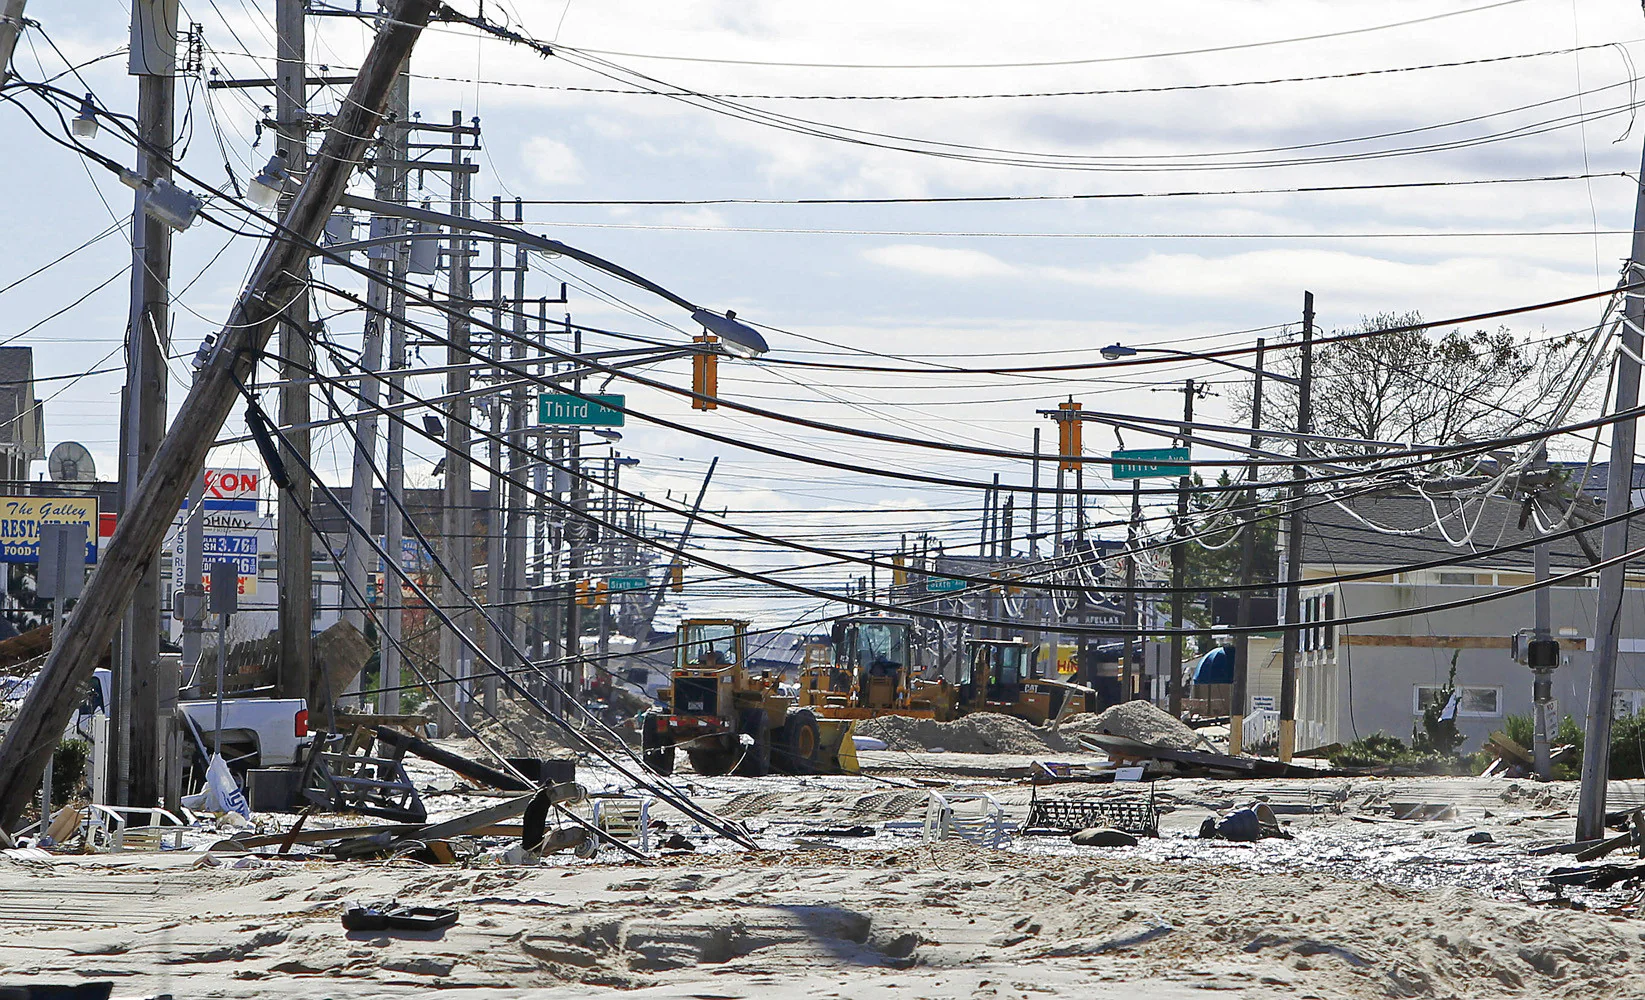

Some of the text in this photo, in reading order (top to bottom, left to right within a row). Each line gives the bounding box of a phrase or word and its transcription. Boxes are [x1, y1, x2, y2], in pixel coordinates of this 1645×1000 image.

[545, 401, 588, 418] Third
[6, 502, 87, 519] The Galley
[204, 516, 251, 528] OHNNY
[218, 538, 250, 552] 3.76
[611, 580, 631, 589] Sixth
[1024, 684, 1039, 694] CAT
